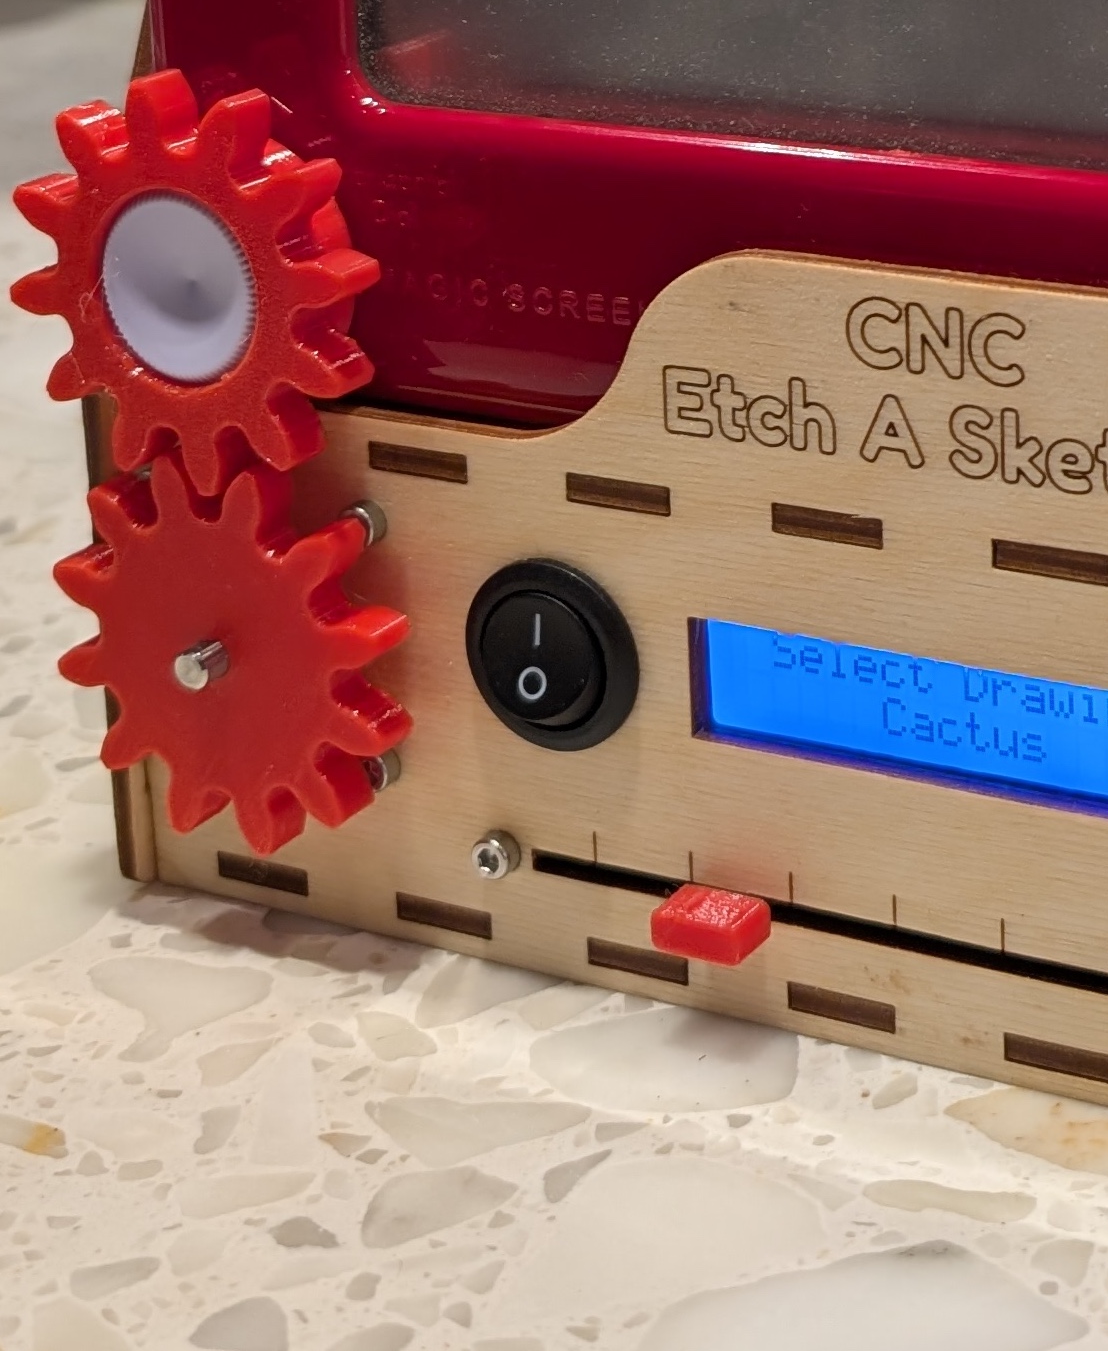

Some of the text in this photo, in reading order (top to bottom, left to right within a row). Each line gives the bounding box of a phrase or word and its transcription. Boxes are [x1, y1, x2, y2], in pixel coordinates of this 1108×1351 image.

[502, 282, 650, 327] SCREE
[845, 295, 1027, 389] CNC
[661, 363, 838, 456] Etch
[859, 393, 926, 470] A
[772, 633, 935, 695] Select
[880, 695, 1048, 764] Cactus
